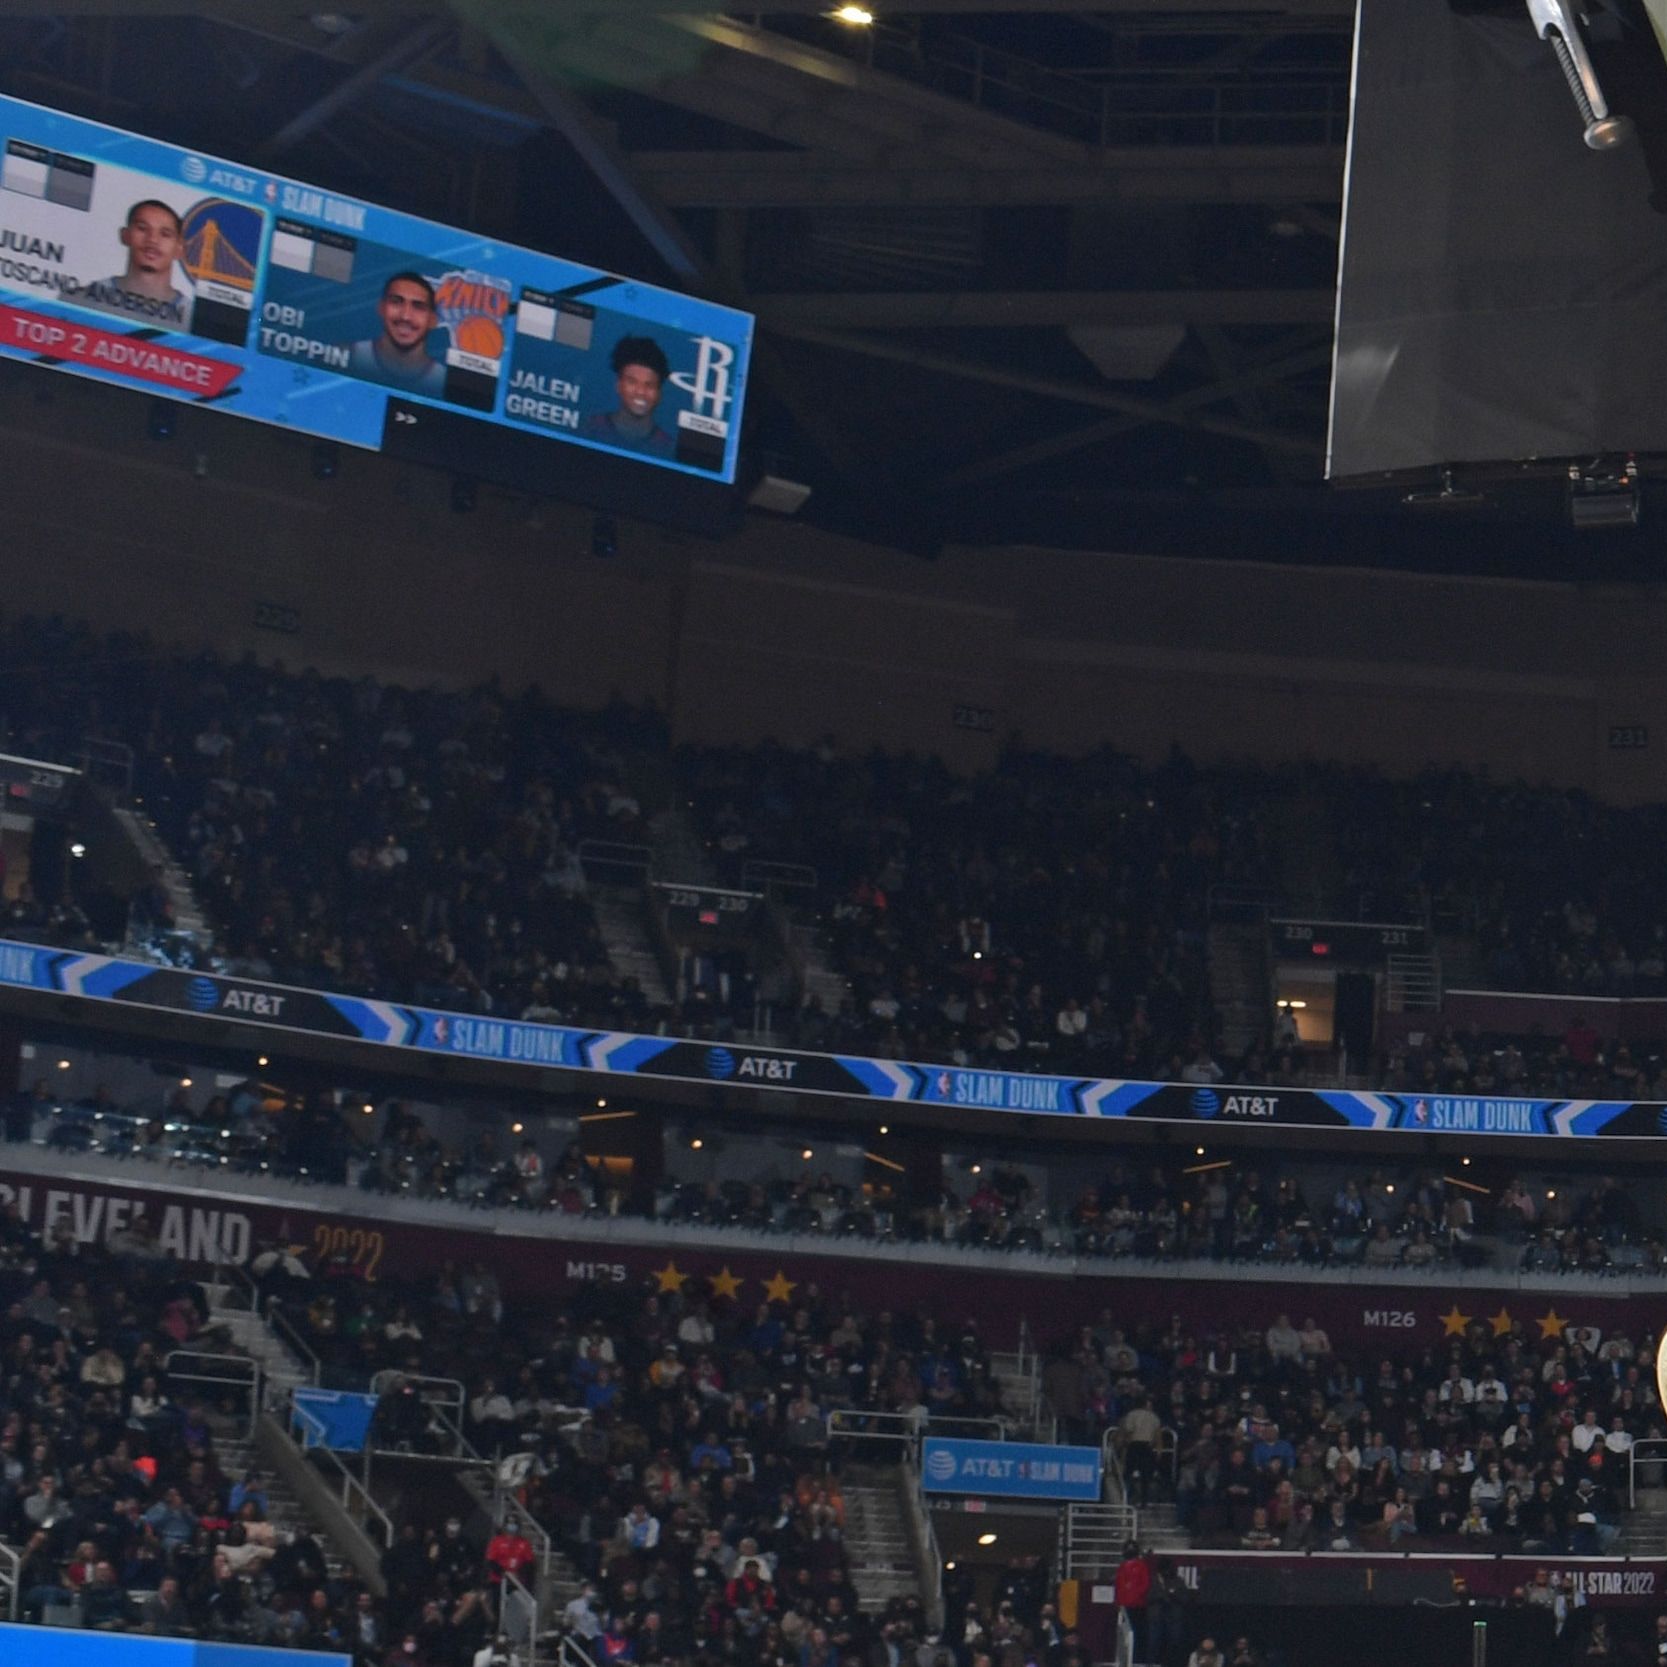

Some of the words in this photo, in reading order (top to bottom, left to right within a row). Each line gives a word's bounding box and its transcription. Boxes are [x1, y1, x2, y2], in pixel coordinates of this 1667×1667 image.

[209, 170, 258, 196] AT&T
[283, 187, 322, 222] SLAM
[0, 230, 65, 264] JUAN
[263, 302, 305, 329] OBI
[14, 317, 66, 344] TOP
[71, 333, 88, 354] 2
[95, 341, 214, 387] ADVANCE
[261, 327, 349, 368] TOPPIN
[510, 370, 580, 404] JALEN
[506, 394, 580, 429] GREEN
[222, 989, 285, 1017] AT&T
[452, 1020, 502, 1052] SLAM
[510, 1027, 564, 1062] DUNK
[739, 1058, 796, 1080] AT&T
[956, 1074, 1002, 1105] SLAM
[1009, 1080, 1059, 1109] DUNK
[1224, 1096, 1279, 1116] AT&T
[1433, 1101, 1478, 1128] SLAM
[1484, 1103, 1532, 1131] DUNK
[1364, 1310, 1416, 1328] M126
[962, 1458, 1015, 1478] AT&T
[1588, 1571, 1621, 1595] STAR
[1624, 1571, 1655, 1594] 2022
